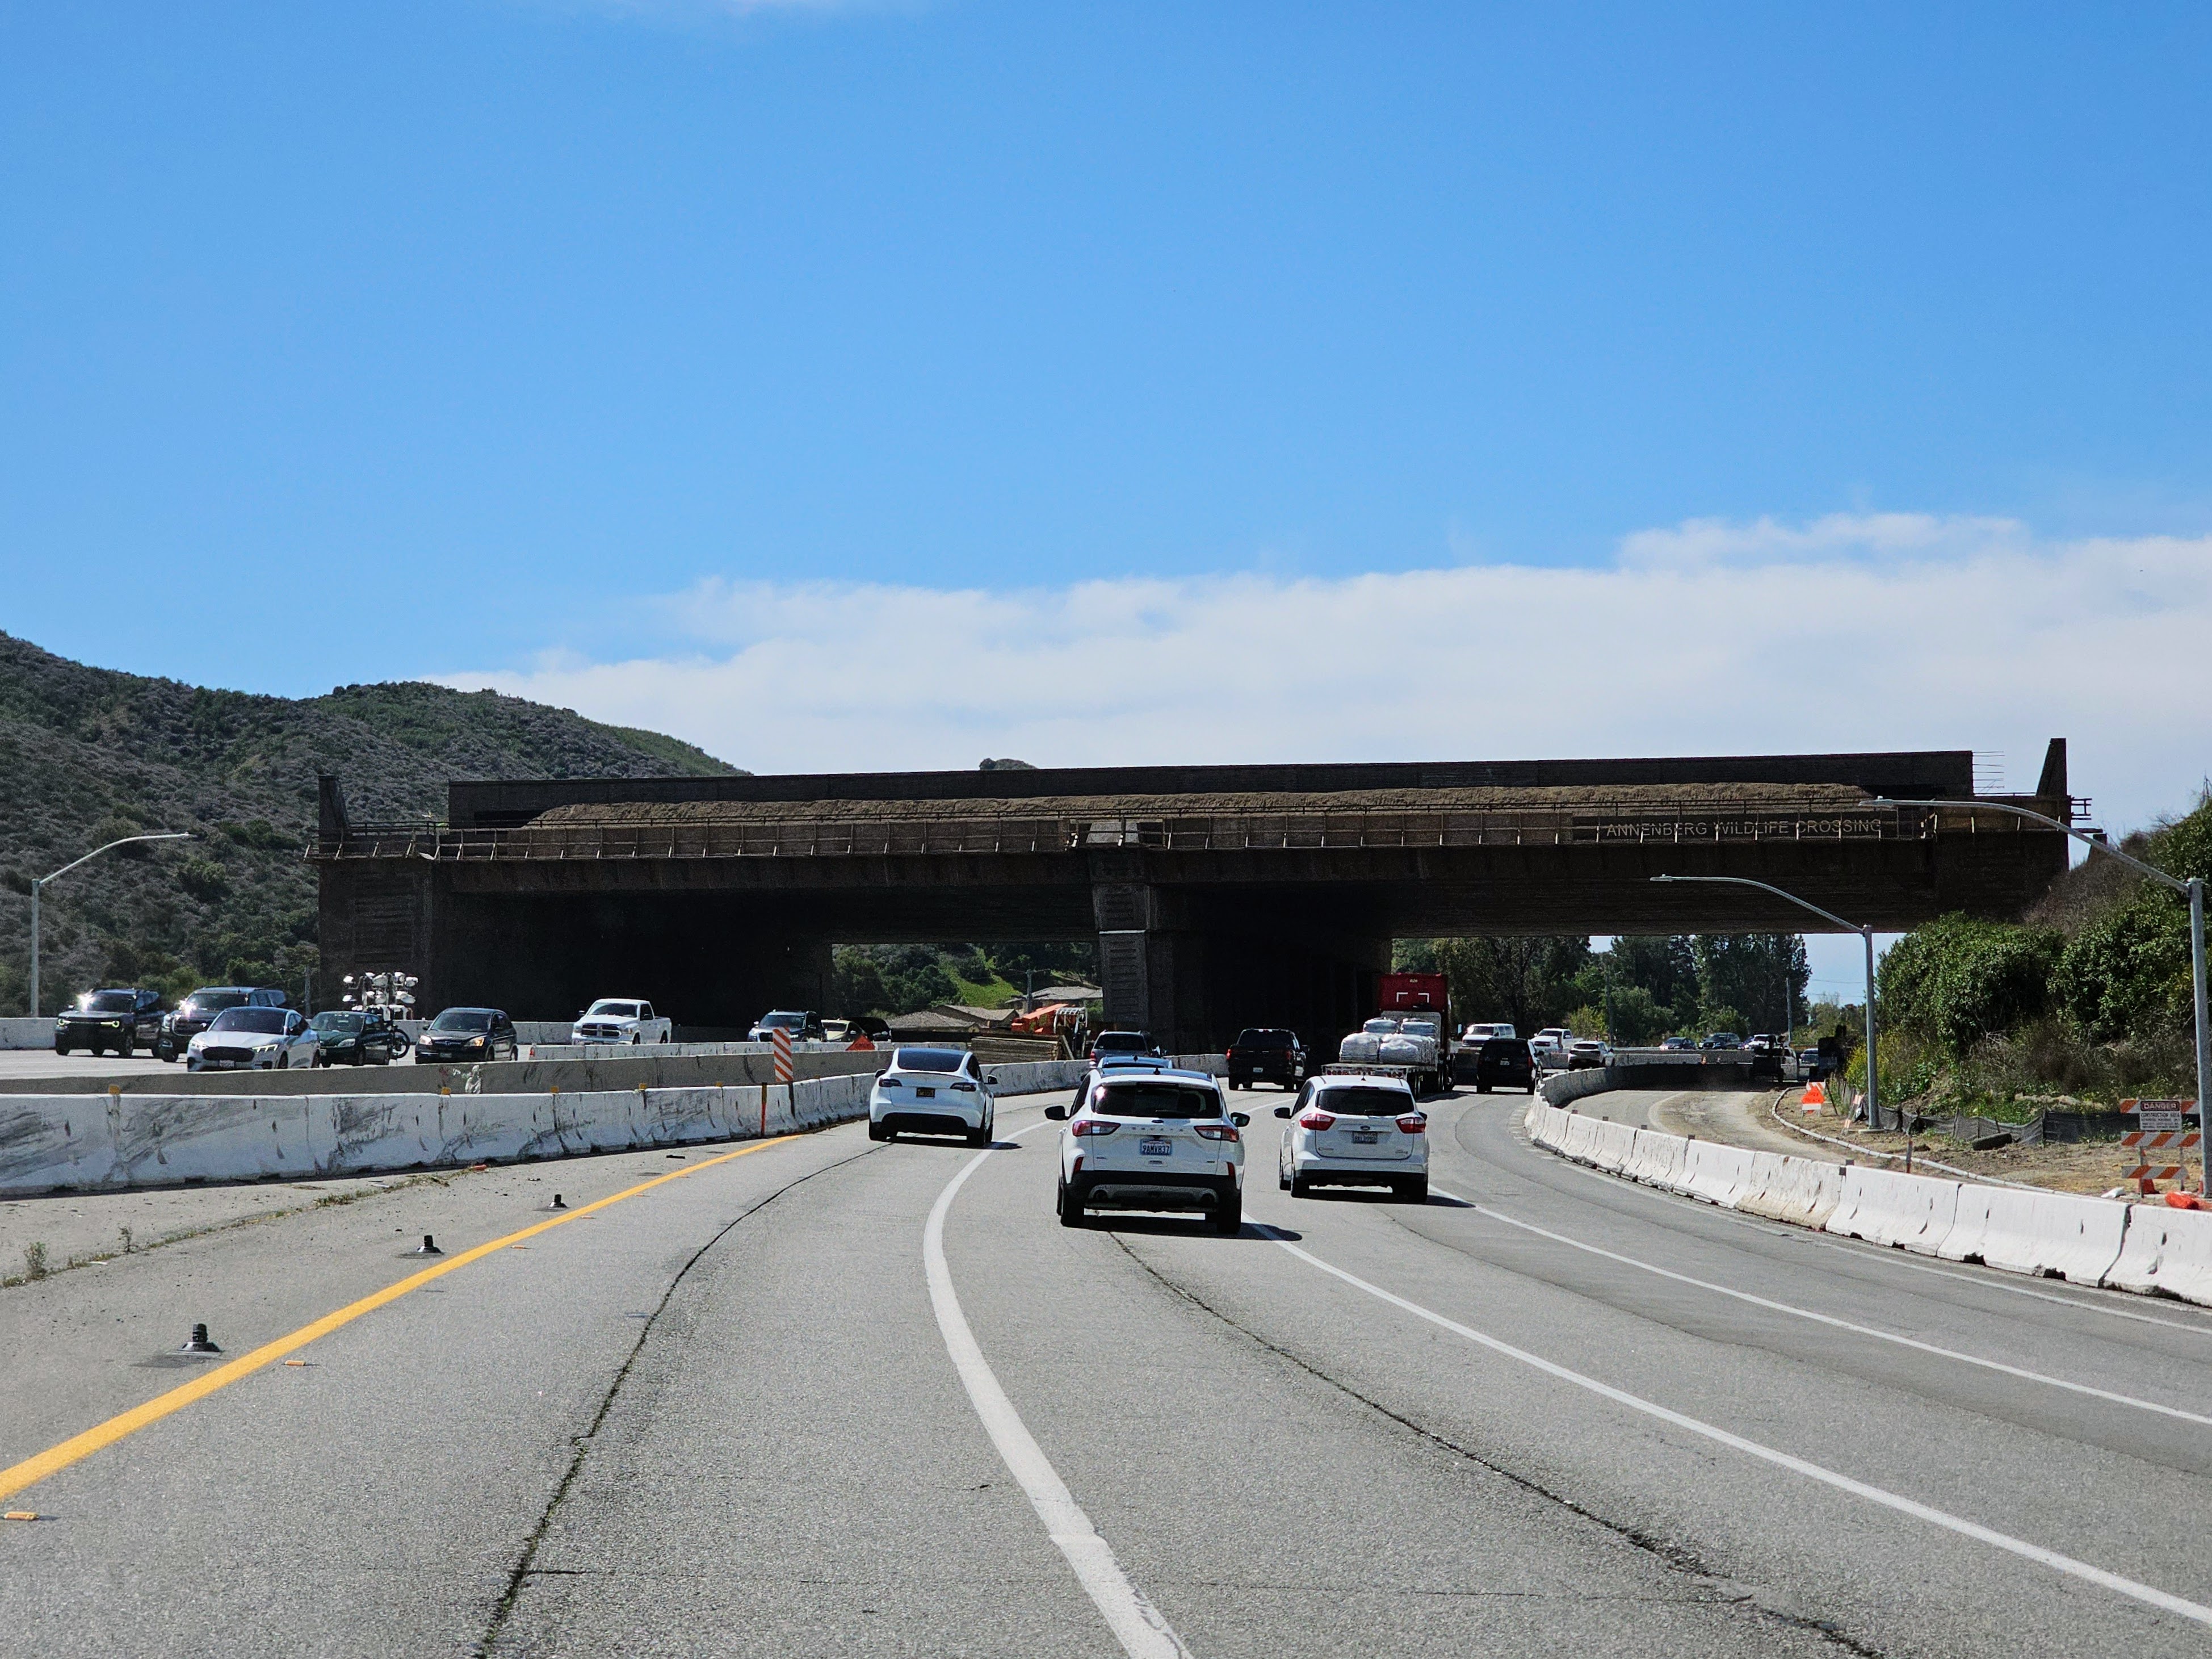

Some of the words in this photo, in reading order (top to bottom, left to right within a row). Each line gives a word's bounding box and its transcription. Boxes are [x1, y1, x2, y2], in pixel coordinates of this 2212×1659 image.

[1606, 822, 1707, 836] ANNENBERG
[1797, 819, 1881, 833] CROSSING
[1142, 1145, 1170, 1154] 9AMV837
